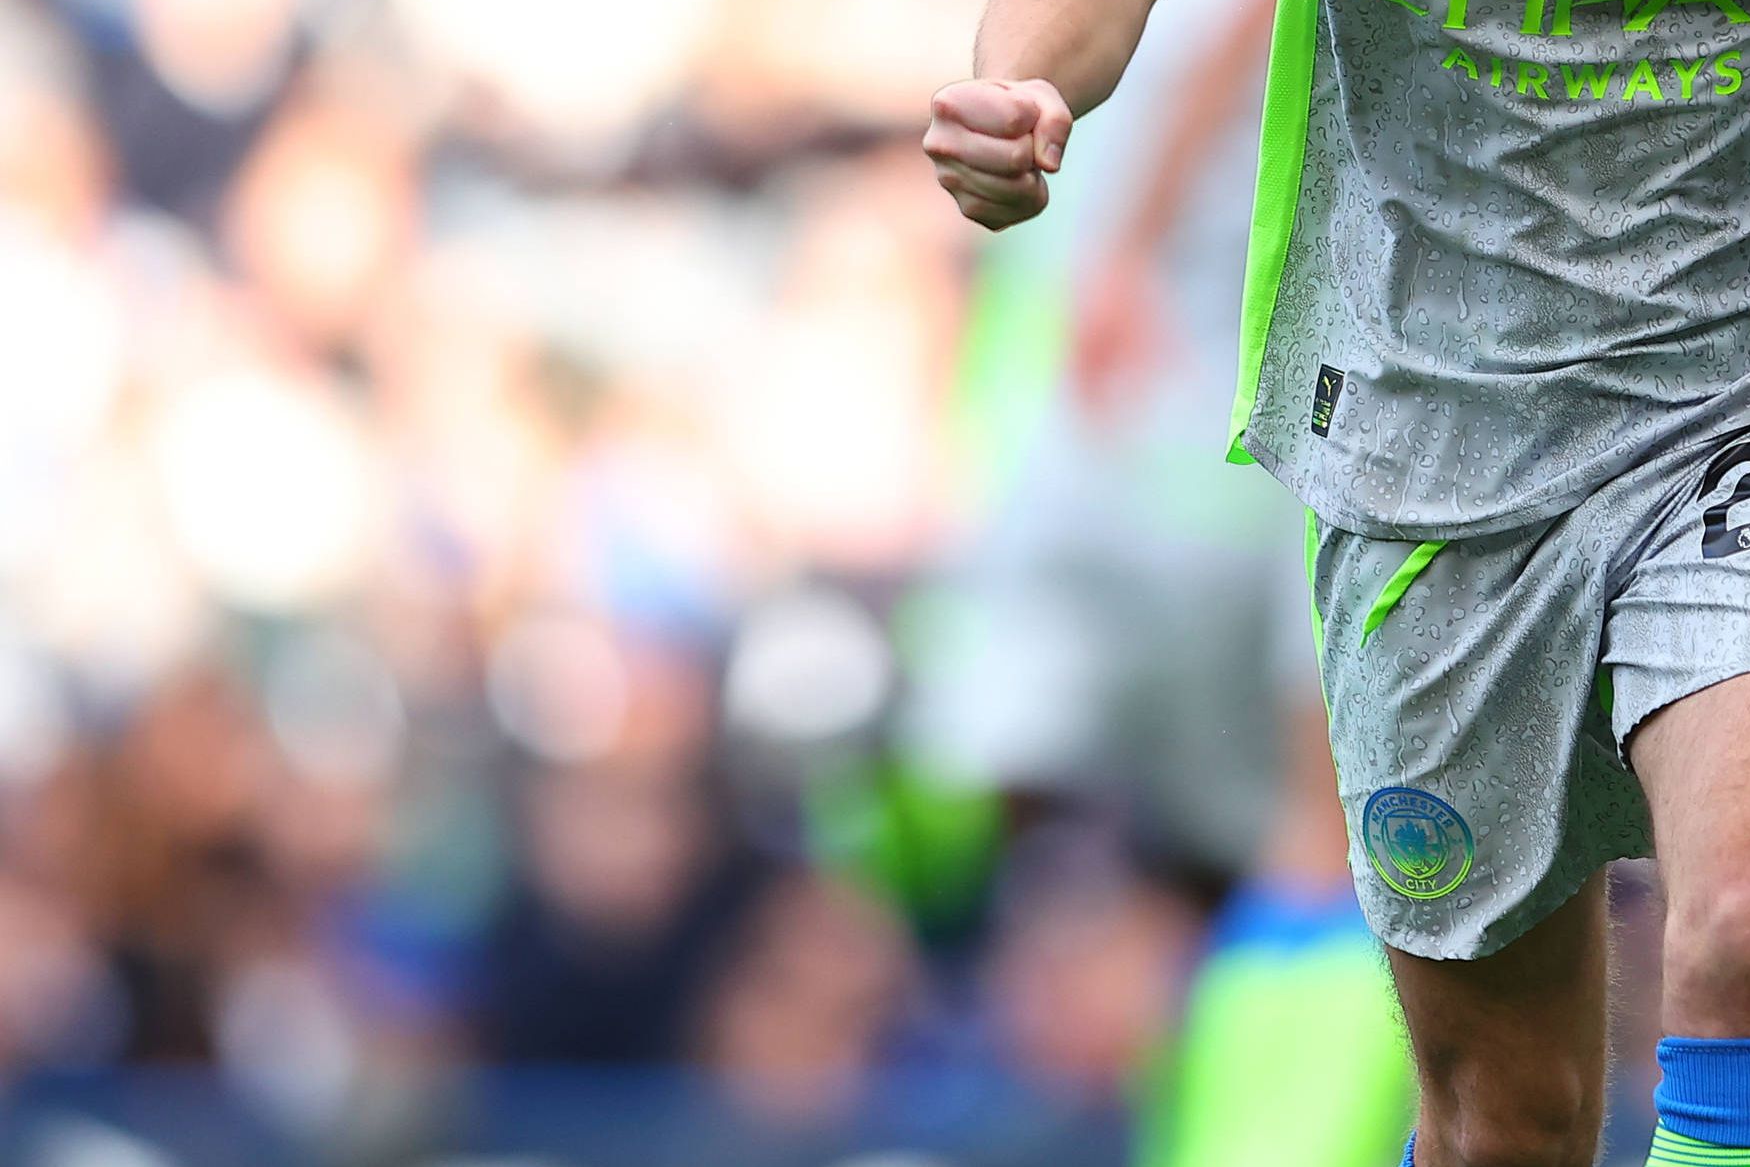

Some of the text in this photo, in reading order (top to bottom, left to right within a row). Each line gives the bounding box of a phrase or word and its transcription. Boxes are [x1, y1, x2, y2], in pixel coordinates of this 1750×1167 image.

[1442, 47, 1744, 101] AIRWAYS
[1372, 795, 1455, 828] MANCHESTER
[1405, 879, 1438, 890] CITY
